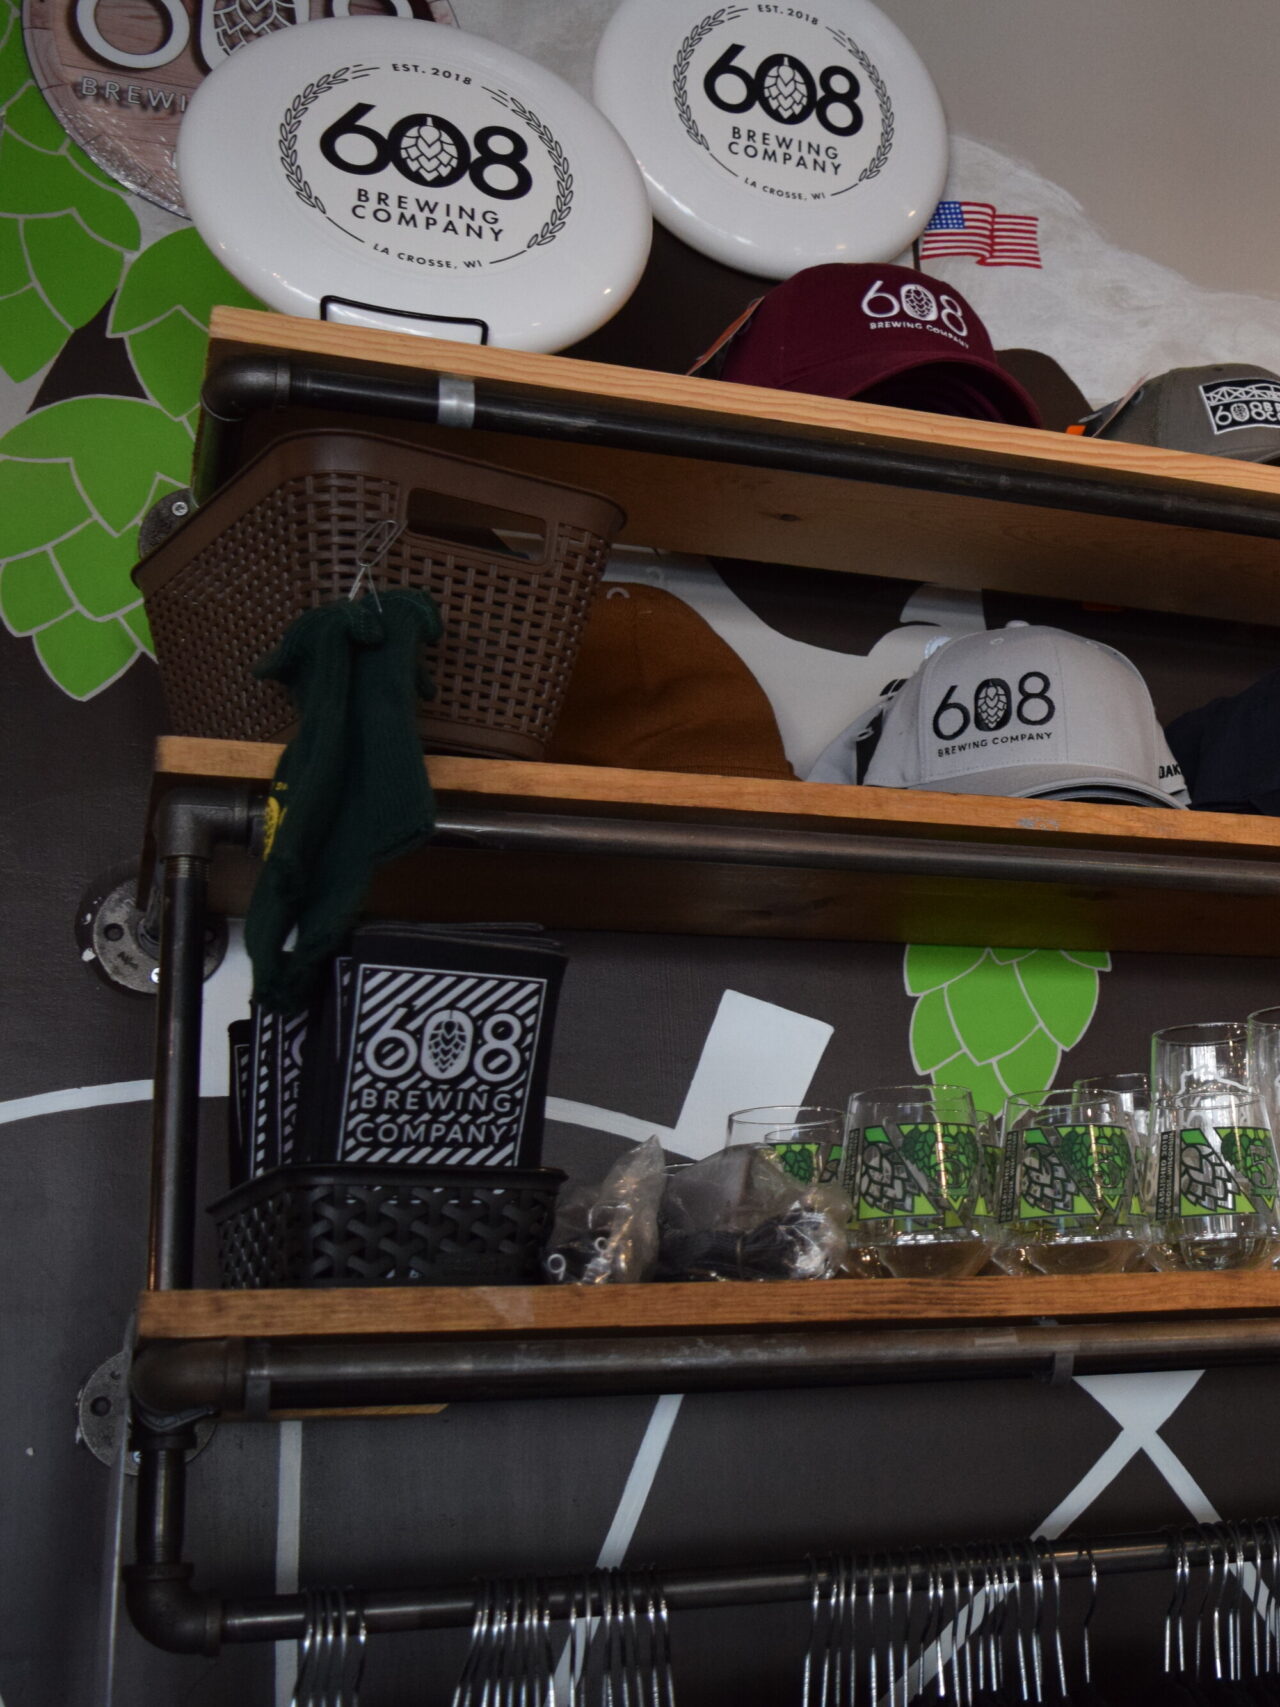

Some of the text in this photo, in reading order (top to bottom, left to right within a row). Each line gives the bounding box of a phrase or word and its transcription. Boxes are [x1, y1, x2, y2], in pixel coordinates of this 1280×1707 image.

[757, 4, 818, 26] EST. 2018
[391, 63, 472, 85] EST. 2018
[703, 43, 863, 137] 608
[81, 76, 187, 113] BREWI
[319, 102, 533, 200] 608
[728, 141, 841, 176] COMPANY
[732, 126, 839, 160] BREWING
[744, 177, 757, 188] LA
[811, 192, 826, 200] WI
[351, 204, 504, 242] COMPANY
[357, 188, 500, 225] BREWING
[373, 243, 390, 255] LA
[464, 260, 482, 269] WI
[861, 280, 968, 337] 608
[869, 321, 923, 330] BREWING
[1215, 401, 1266, 426] 608
[932, 671, 1056, 741] 608
[937, 731, 1053, 758] BREWING COMPANY
[365, 1007, 522, 1082] 608
[360, 1088, 513, 1113] BREWING
[355, 1122, 508, 1144] COMPANY
